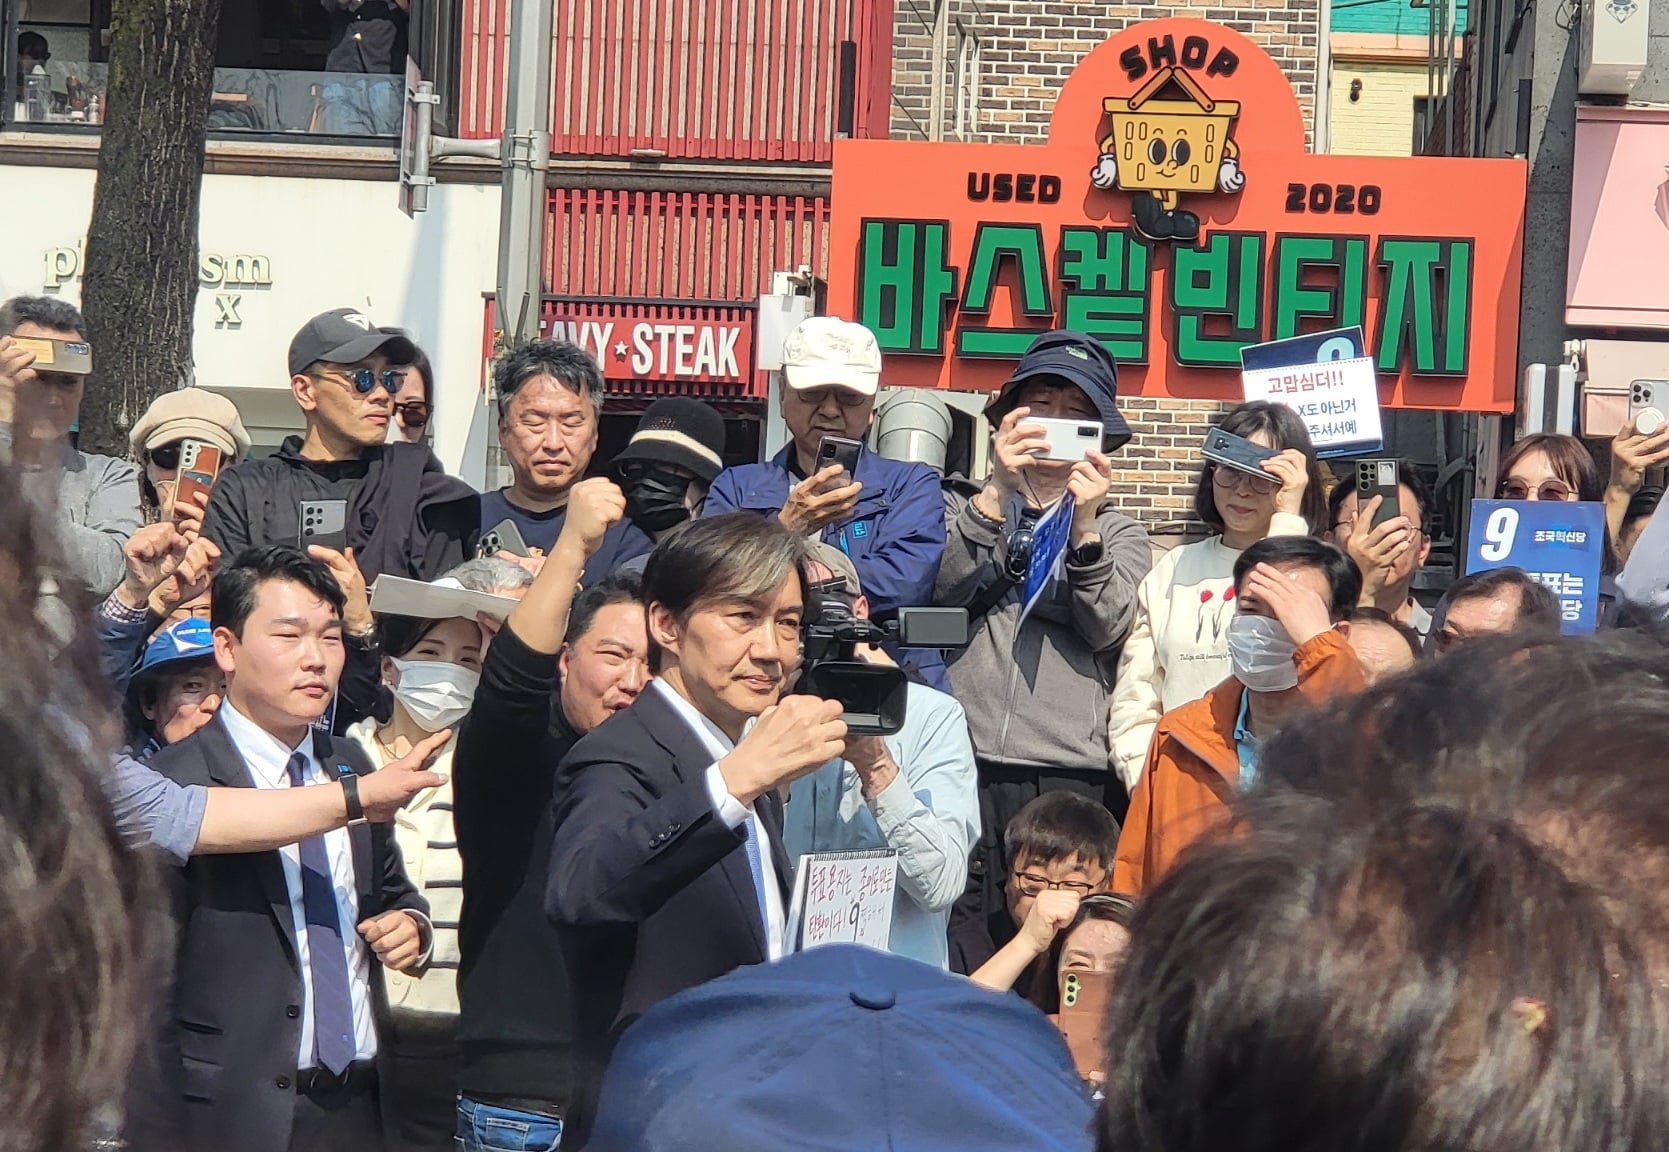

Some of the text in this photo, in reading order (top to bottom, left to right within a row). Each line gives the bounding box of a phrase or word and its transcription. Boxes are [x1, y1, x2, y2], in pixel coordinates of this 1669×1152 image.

[1120, 34, 1240, 82] SHOP
[967, 172, 1062, 204] USED
[1285, 183, 1381, 215] 2020
[631, 322, 741, 378] STEAK
[1267, 370, 1345, 394] 고맙심더!!
[1480, 507, 1520, 562] 9
[1534, 530, 1587, 543] 조국혁신당
[1528, 572, 1584, 595] 표는
